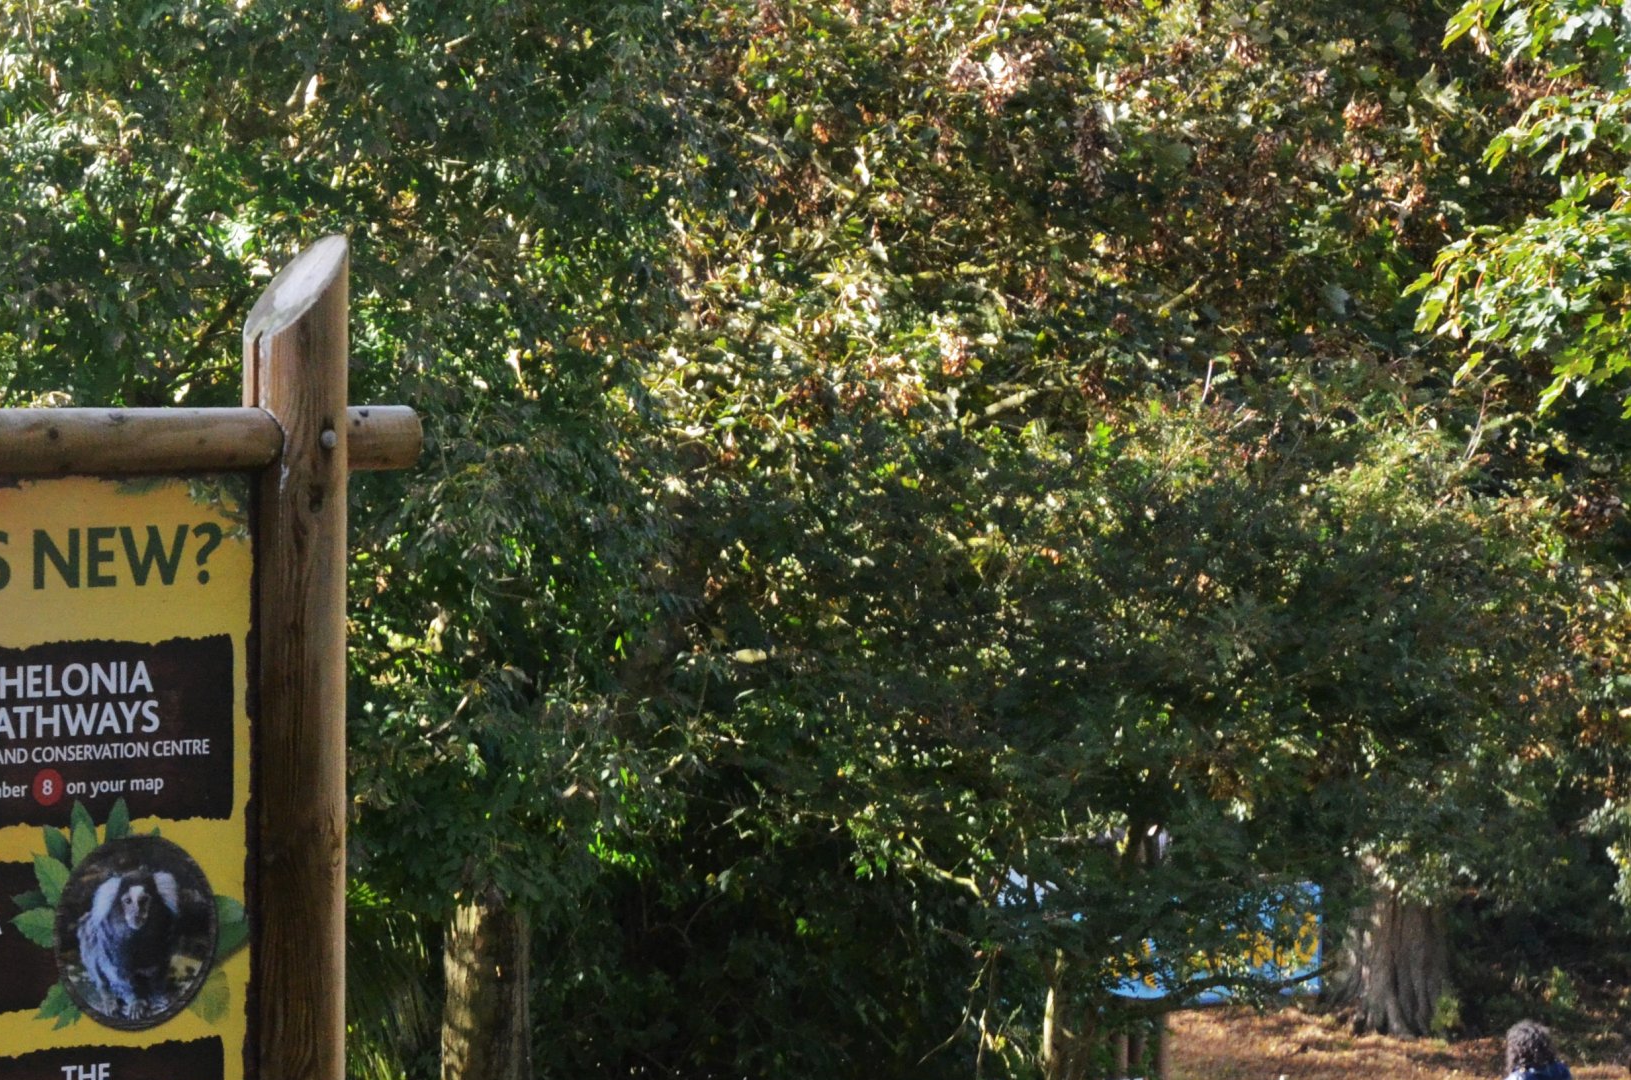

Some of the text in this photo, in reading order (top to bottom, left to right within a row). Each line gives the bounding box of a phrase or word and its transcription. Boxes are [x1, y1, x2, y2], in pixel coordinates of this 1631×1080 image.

[32, 521, 224, 591] NEW?
[31, 740, 150, 763] CONSERVATION
[152, 738, 211, 756] CENTRE
[41, 779, 53, 797] 8
[66, 781, 87, 795] on
[89, 779, 127, 800] your
[129, 777, 165, 798] map
